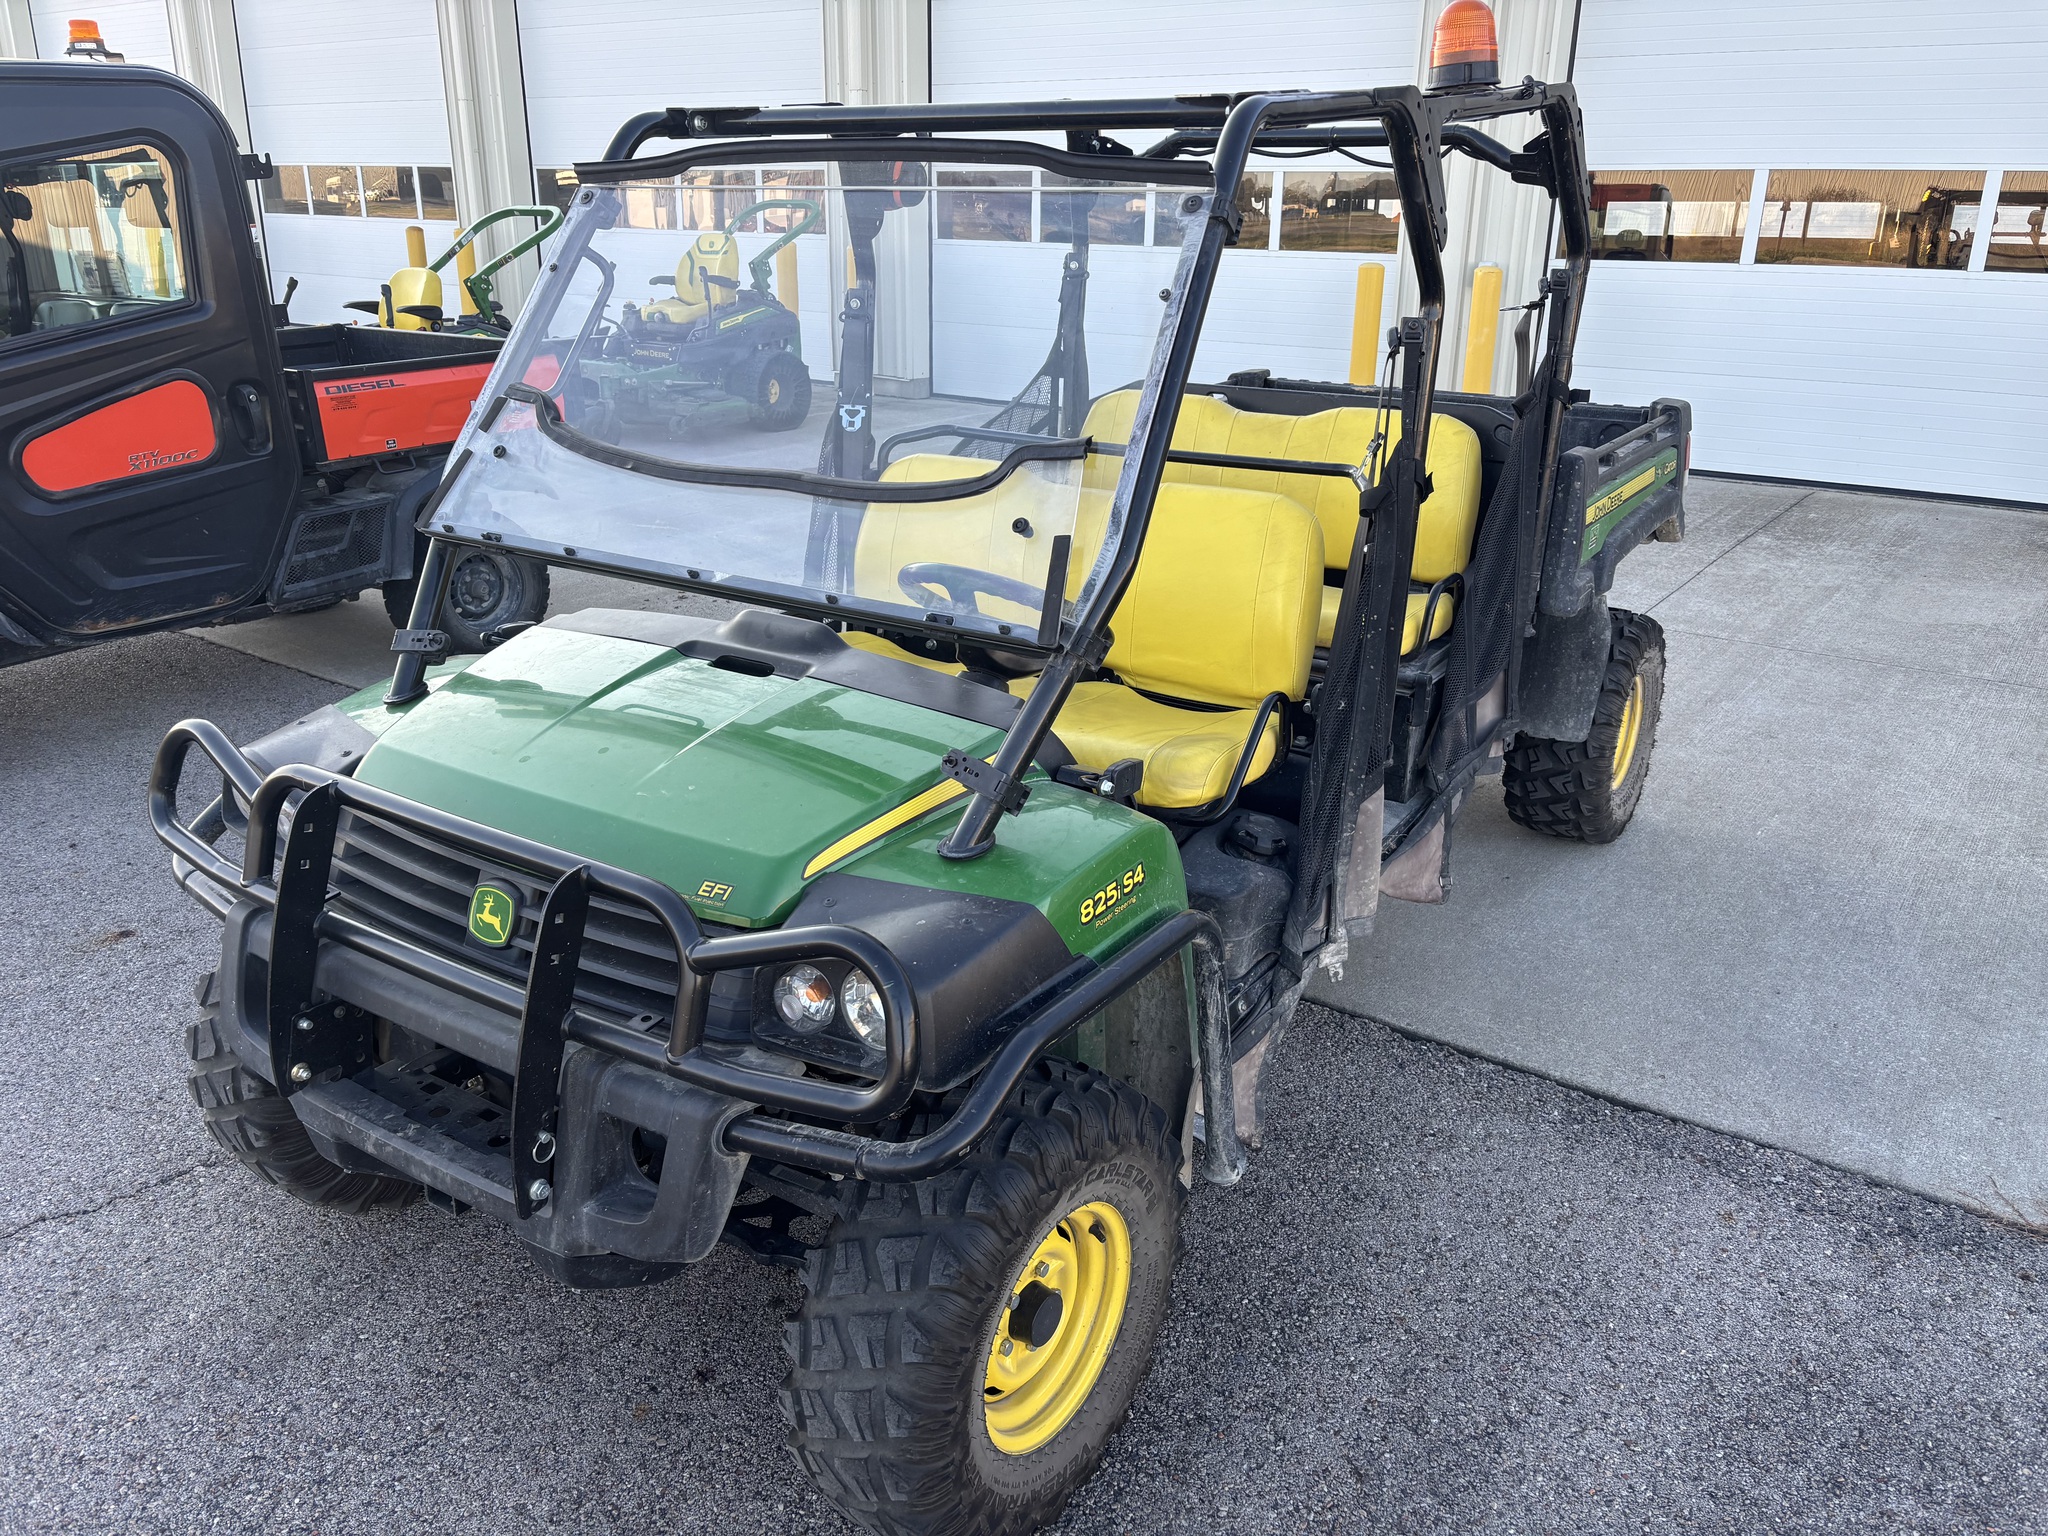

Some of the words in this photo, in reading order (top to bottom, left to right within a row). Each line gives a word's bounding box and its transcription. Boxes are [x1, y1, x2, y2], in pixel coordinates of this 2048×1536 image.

[650, 349, 670, 359] DEERE
[324, 379, 406, 395] DIESEL
[128, 449, 160, 463] RTV
[128, 449, 198, 472] X1100C
[1592, 502, 1607, 522] JOHN
[1606, 491, 1624, 512] DEERE
[697, 880, 733, 901] EFI
[1080, 881, 1121, 924] 825i
[1123, 863, 1145, 894] S4
[1095, 912, 1113, 929] Power
[1114, 895, 1137, 915] Steering
